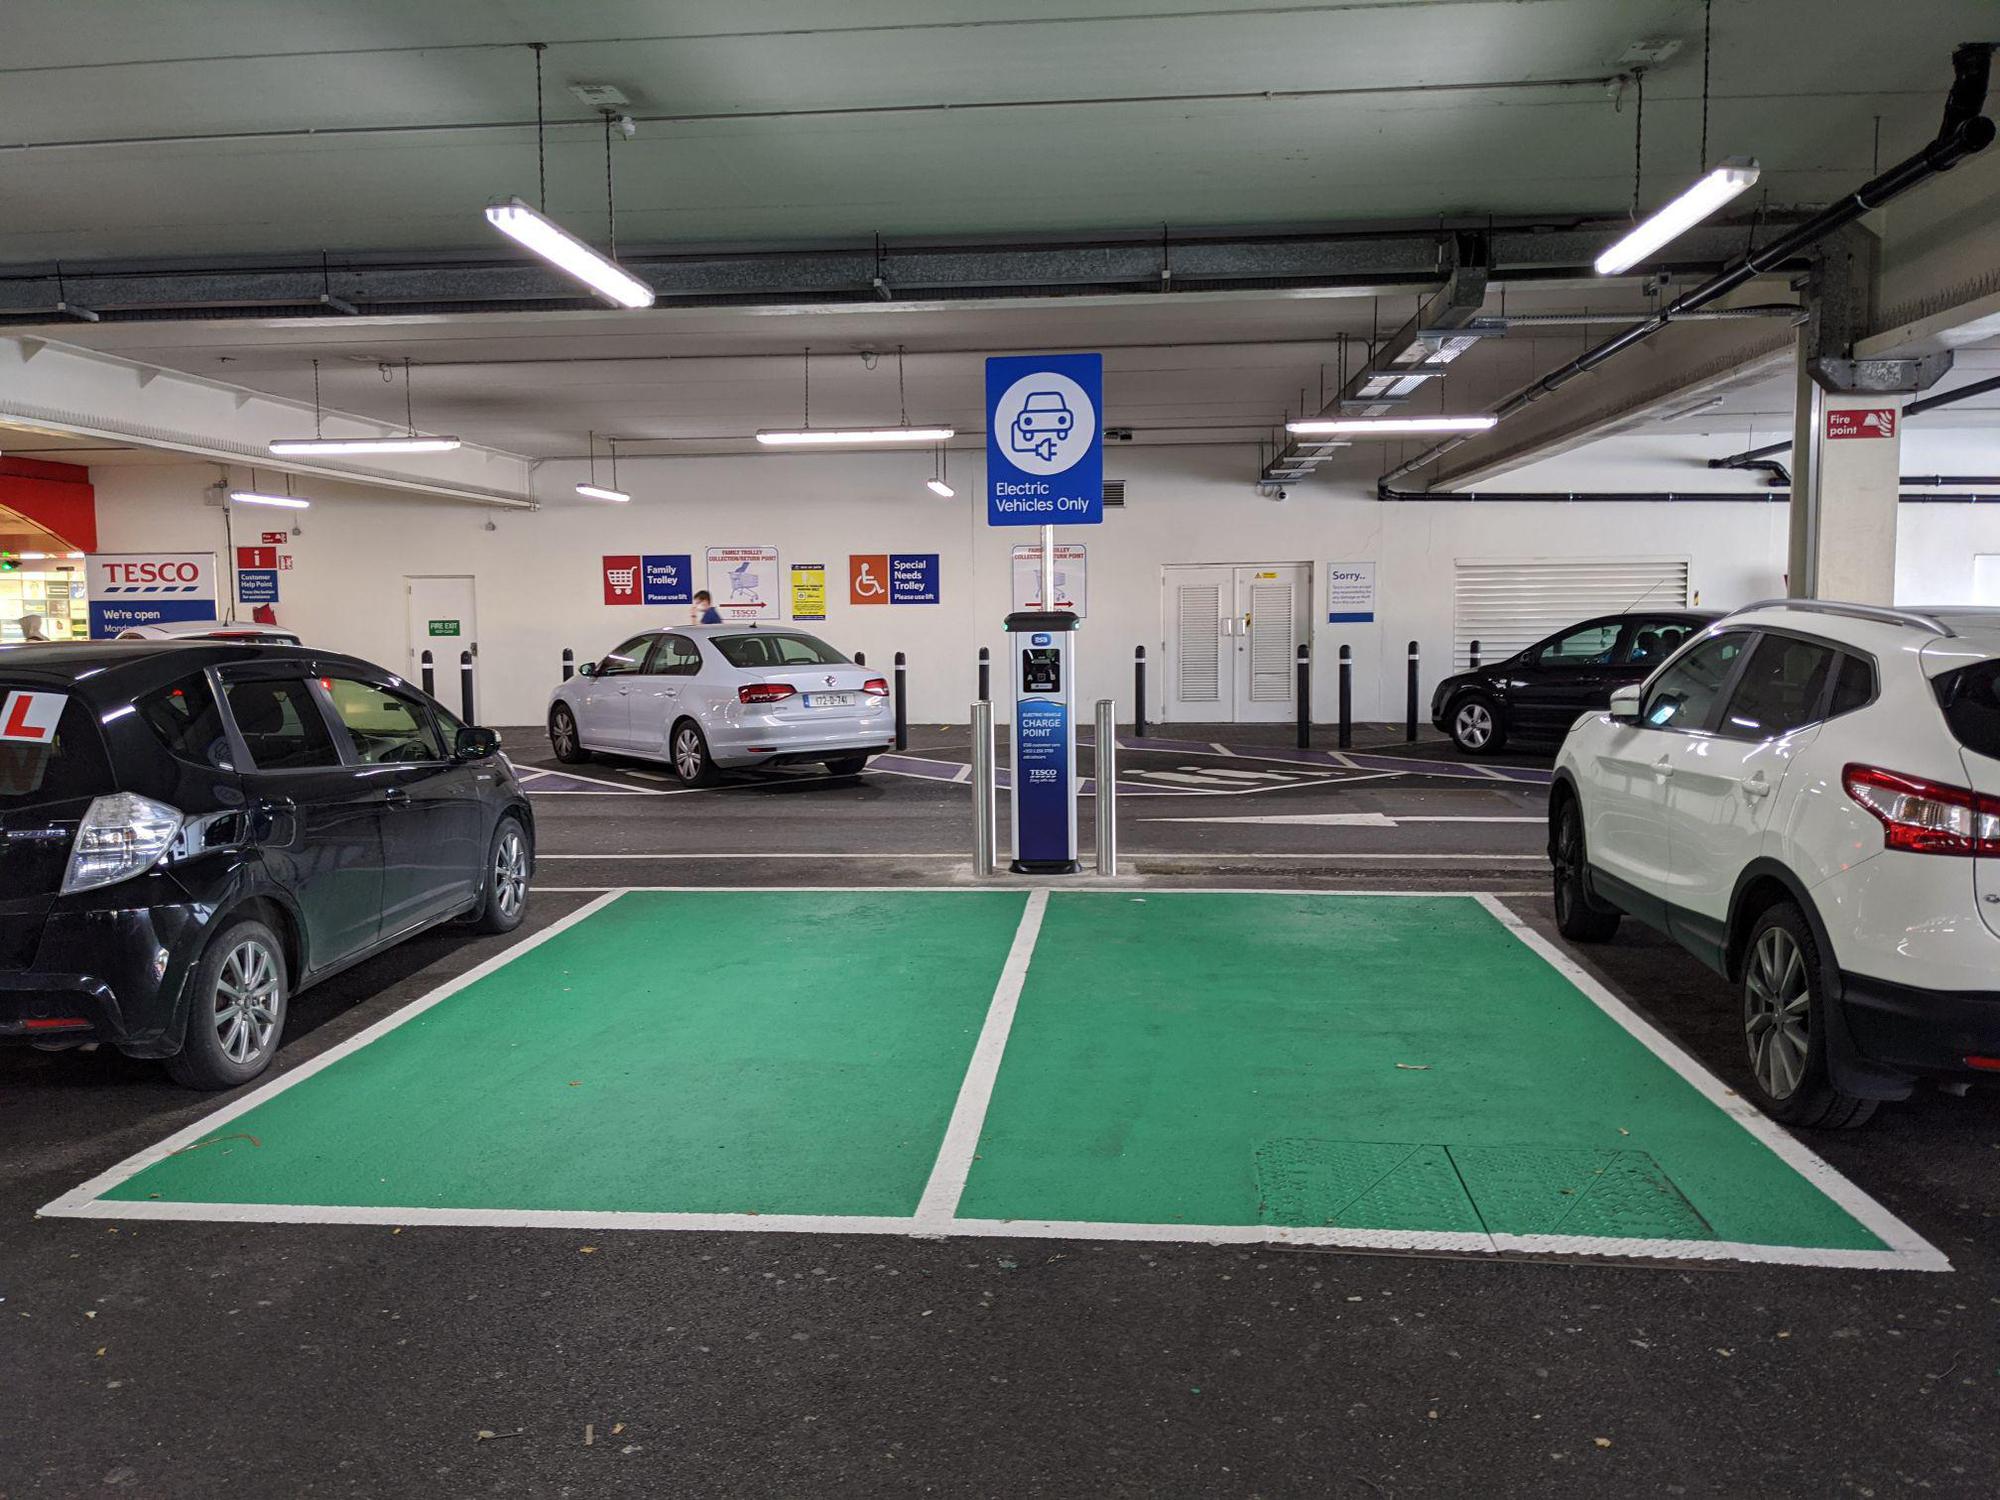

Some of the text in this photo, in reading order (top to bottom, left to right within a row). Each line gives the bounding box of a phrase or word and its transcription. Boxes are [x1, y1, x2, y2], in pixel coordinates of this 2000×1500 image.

[1830, 415, 1850, 424] Fire
[1830, 425, 1857, 437] point
[996, 482, 1050, 496] Electric
[996, 497, 1090, 513] Vehicles Only
[647, 565, 676, 575] Family
[894, 560, 926, 570] Special
[102, 562, 199, 583] TESCO
[894, 571, 922, 580] Needs
[647, 576, 678, 586] Trolley
[894, 581, 925, 591] Trolley
[103, 609, 160, 622] We're open
[3, 695, 46, 739] L
[1023, 718, 1062, 728] CHARGE
[1023, 728, 1052, 737] POINT
[1029, 768, 1058, 776] TESCO
